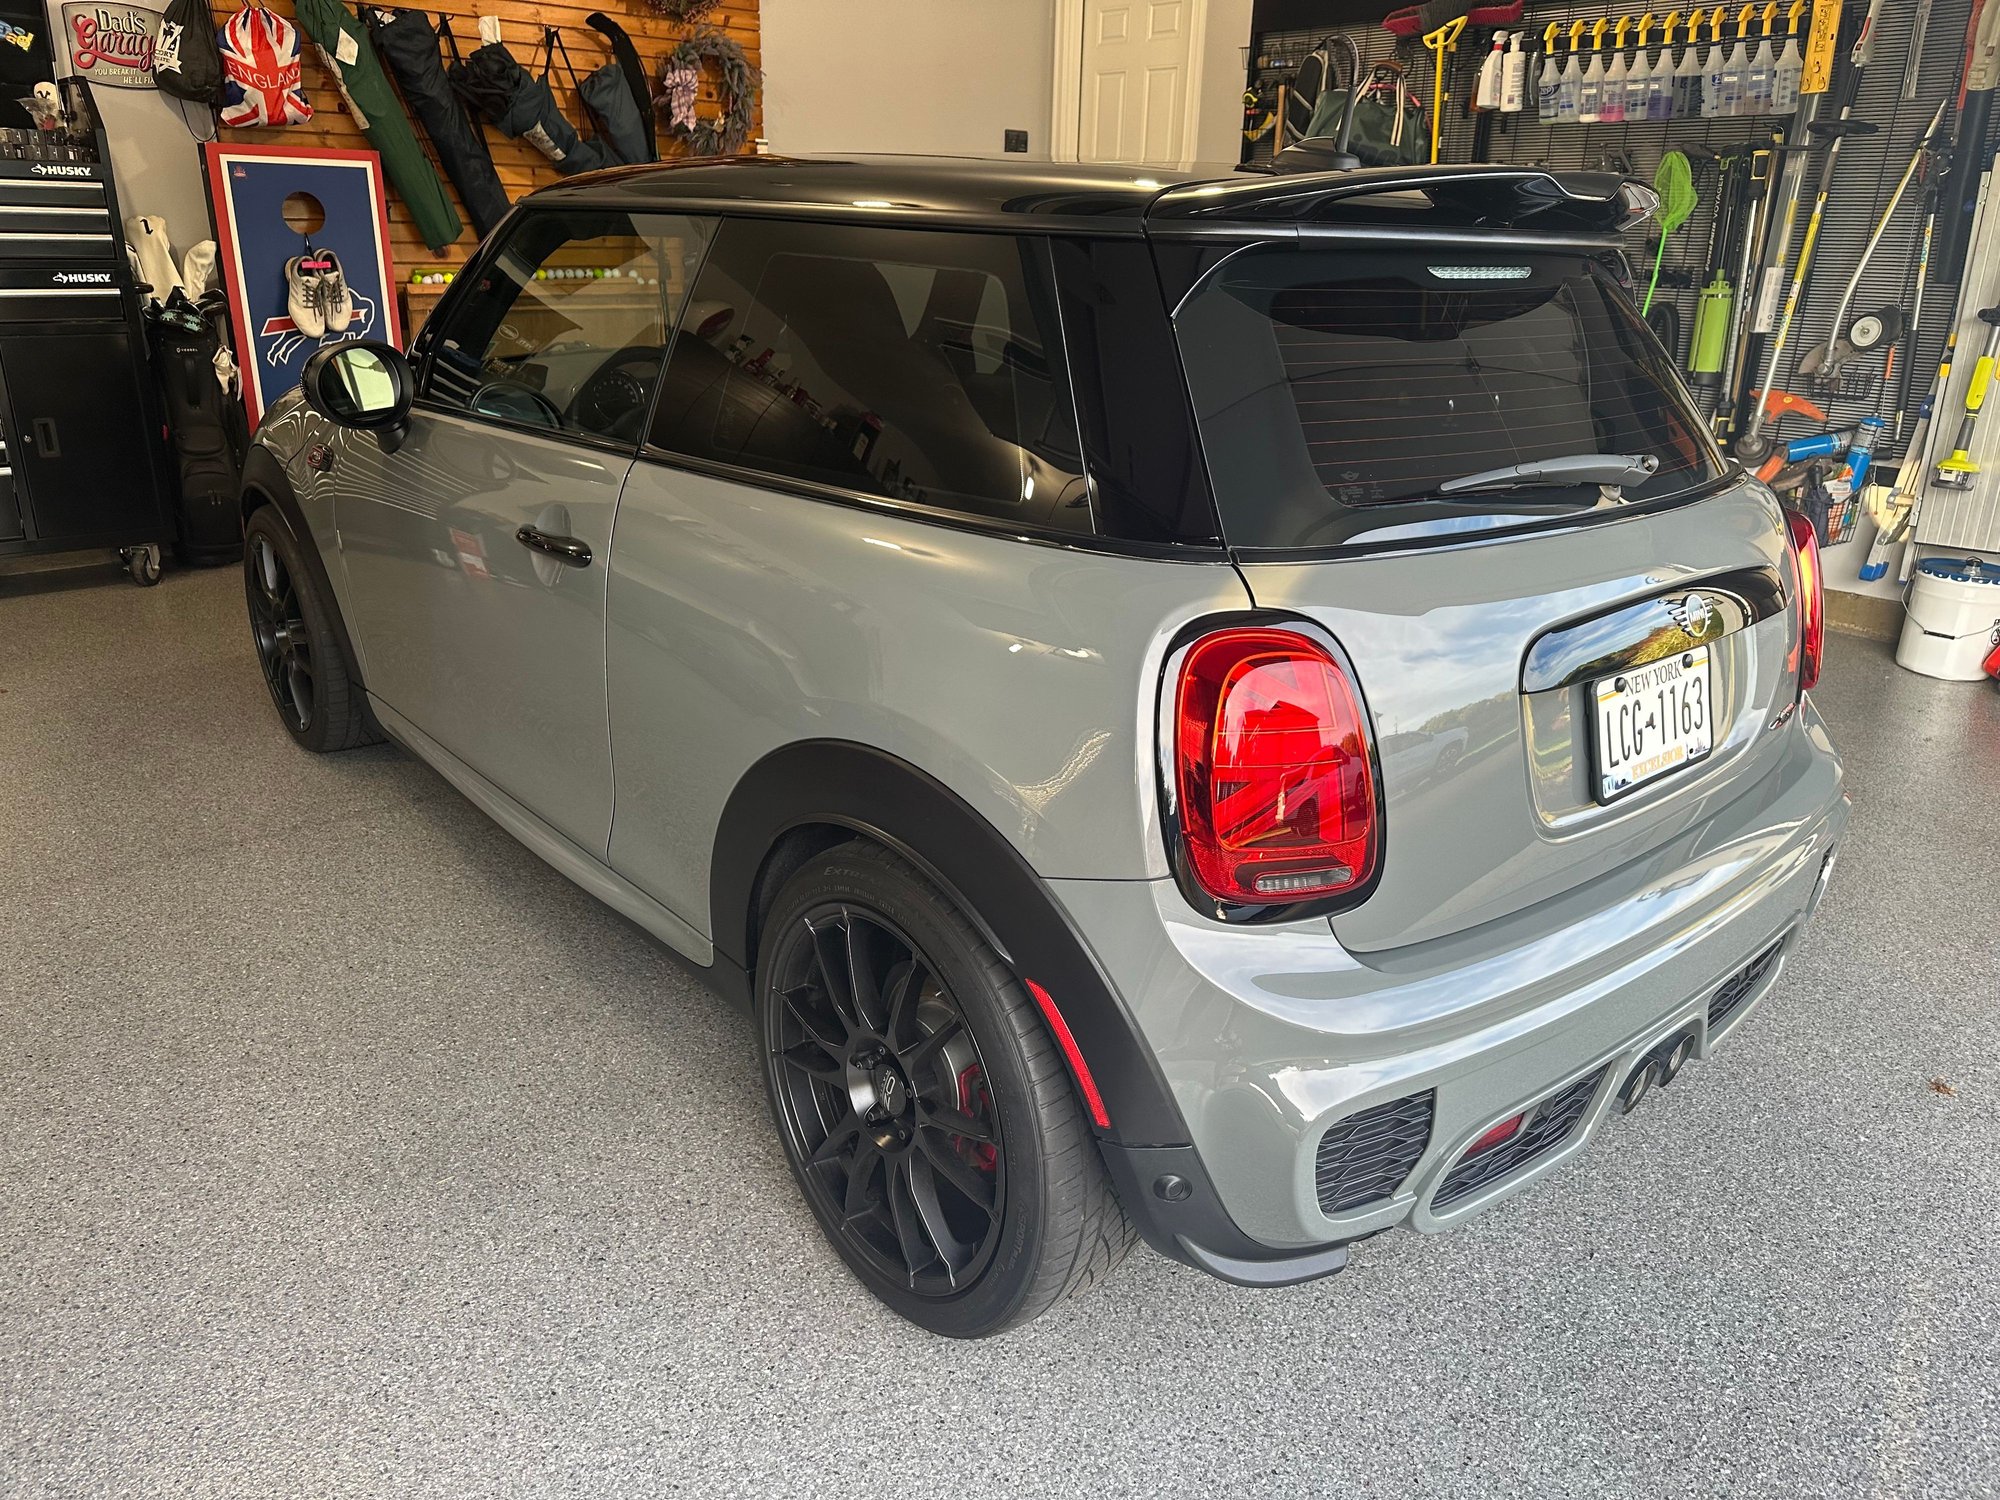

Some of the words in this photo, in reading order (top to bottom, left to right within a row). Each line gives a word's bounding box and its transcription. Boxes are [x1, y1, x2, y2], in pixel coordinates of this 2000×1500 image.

[96, 8, 147, 35] Dad's
[71, 14, 156, 72] Garag
[94, 68, 108, 76] YOU
[109, 68, 130, 76] BREAK
[123, 76, 142, 84] HE'LL
[226, 60, 300, 88] ENGLAND
[47, 165, 91, 176] HUSKY
[1713, 174, 1724, 219] VOYAGER
[68, 273, 111, 283] HUSKY
[1689, 608, 1705, 623] MINI
[1625, 670, 1652, 697] NEW
[1653, 660, 1682, 686] YORK
[1607, 699, 1643, 768] LCG
[1658, 676, 1703, 744] 1163
[1632, 745, 1684, 780] EXCELSIOR
